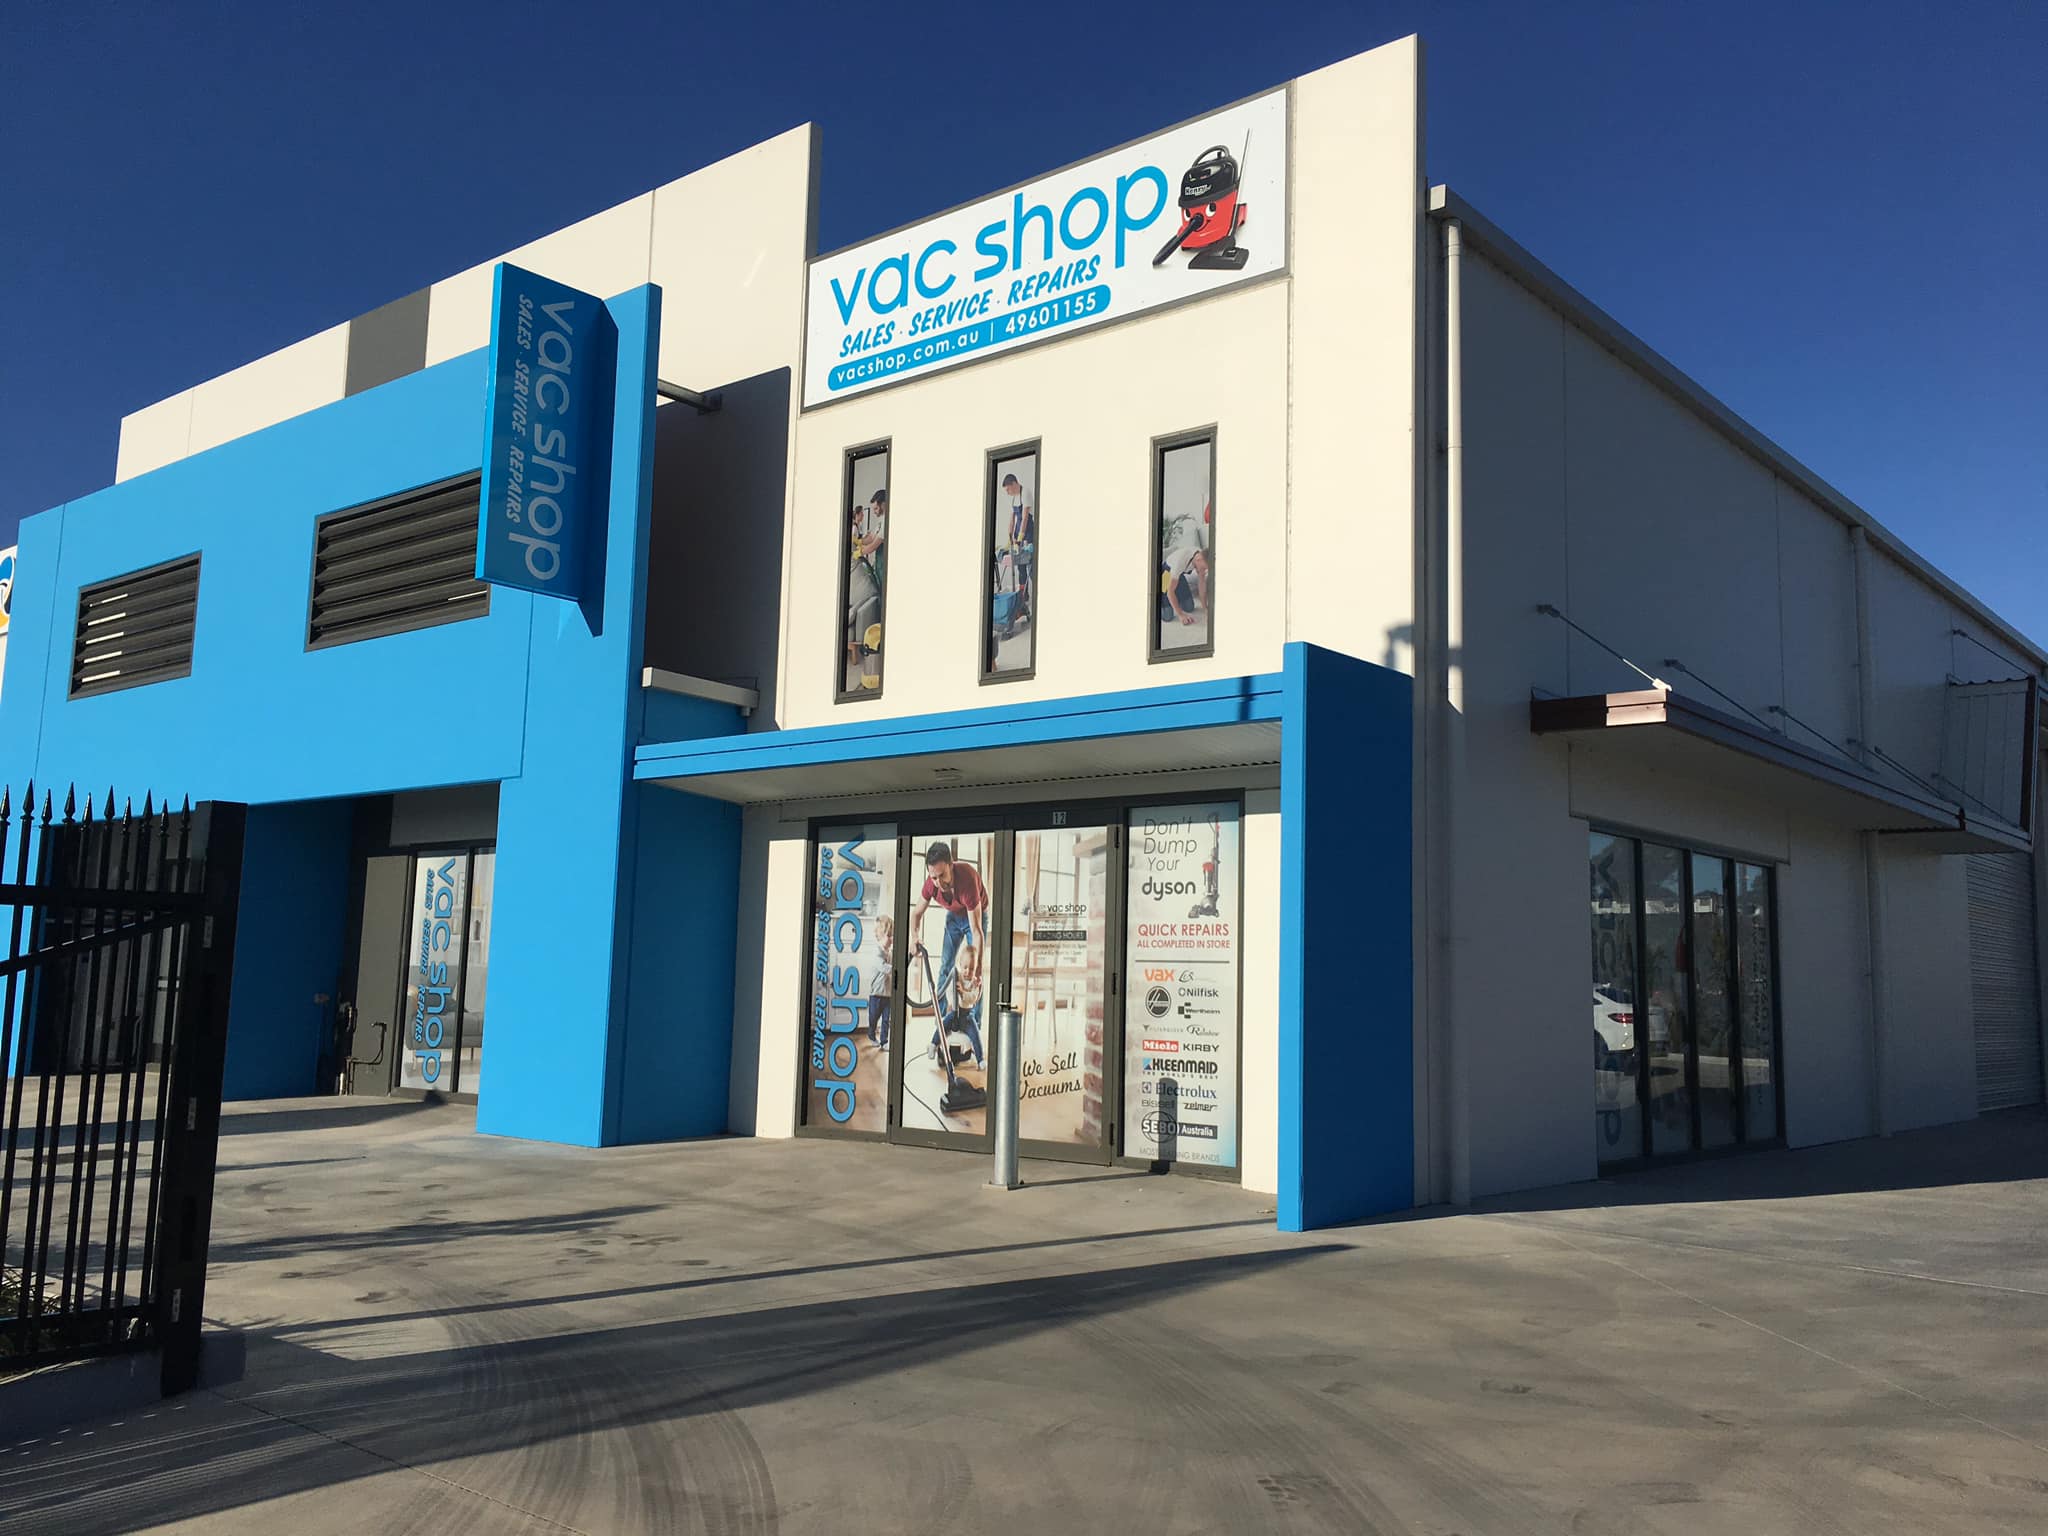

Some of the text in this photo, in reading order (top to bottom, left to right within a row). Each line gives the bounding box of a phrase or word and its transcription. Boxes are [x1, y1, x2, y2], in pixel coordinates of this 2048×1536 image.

[830, 165, 1168, 326] vac shop
[838, 255, 1102, 358] SALES SERVICE REPAIRS
[836, 293, 1097, 384] vacshop.com.au 49601155
[506, 293, 533, 524] SALES SERVICE REPAIRS
[508, 300, 577, 581] vac shop
[1143, 816, 1193, 836] Don't
[1143, 837, 1197, 856] Dump
[1148, 857, 1180, 871] Your
[1141, 876, 1196, 901] dyson
[1047, 903, 1087, 915] vac shop
[1138, 924, 1229, 937] QUICK REPAIRS
[1137, 940, 1230, 949] ALL COMPLETED IN STORE
[415, 868, 435, 1042] SALES SERVICE REPAIRS
[812, 847, 833, 1070] SALES SERVICE REPAIRS
[415, 858, 456, 1084] vac shop
[814, 833, 869, 1123] vac shop
[1144, 968, 1175, 982] vax
[1187, 988, 1219, 998] Nilfisk
[1144, 1041, 1220, 1052] Miele KIRBY
[1023, 1051, 1078, 1077] We Sell
[1152, 1058, 1218, 1075] KLEENMAID
[1156, 1082, 1217, 1099] Electrolux
[1142, 1119, 1213, 1137] SEBO Australia
